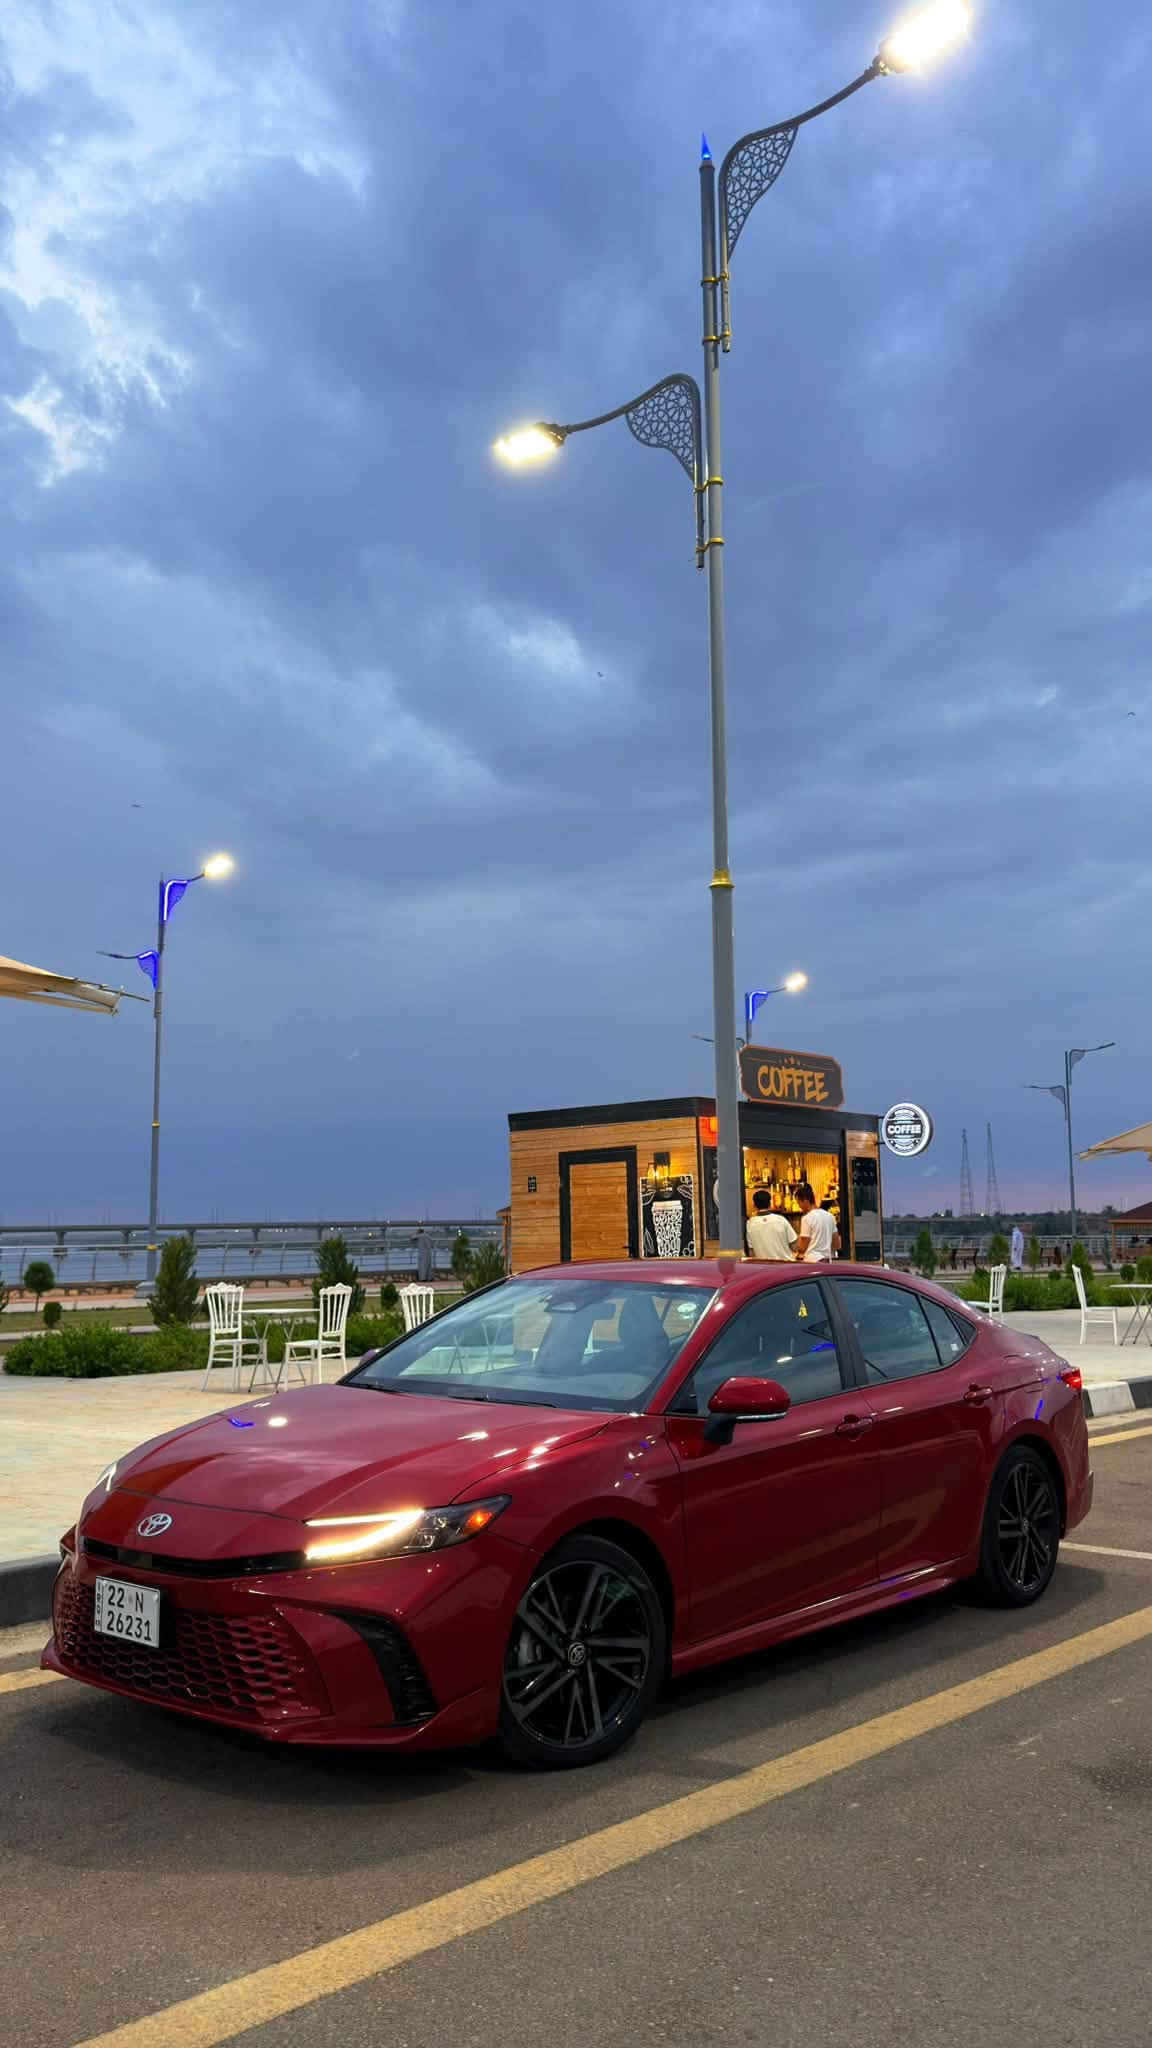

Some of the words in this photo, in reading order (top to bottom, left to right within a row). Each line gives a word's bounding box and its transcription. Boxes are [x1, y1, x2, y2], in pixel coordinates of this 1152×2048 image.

[757, 1065, 829, 1103] COFFEE
[887, 1124, 921, 1134] COFFEE
[108, 1585, 125, 1609] 22
[135, 1591, 144, 1614] N
[106, 1610, 152, 1641] 26231
